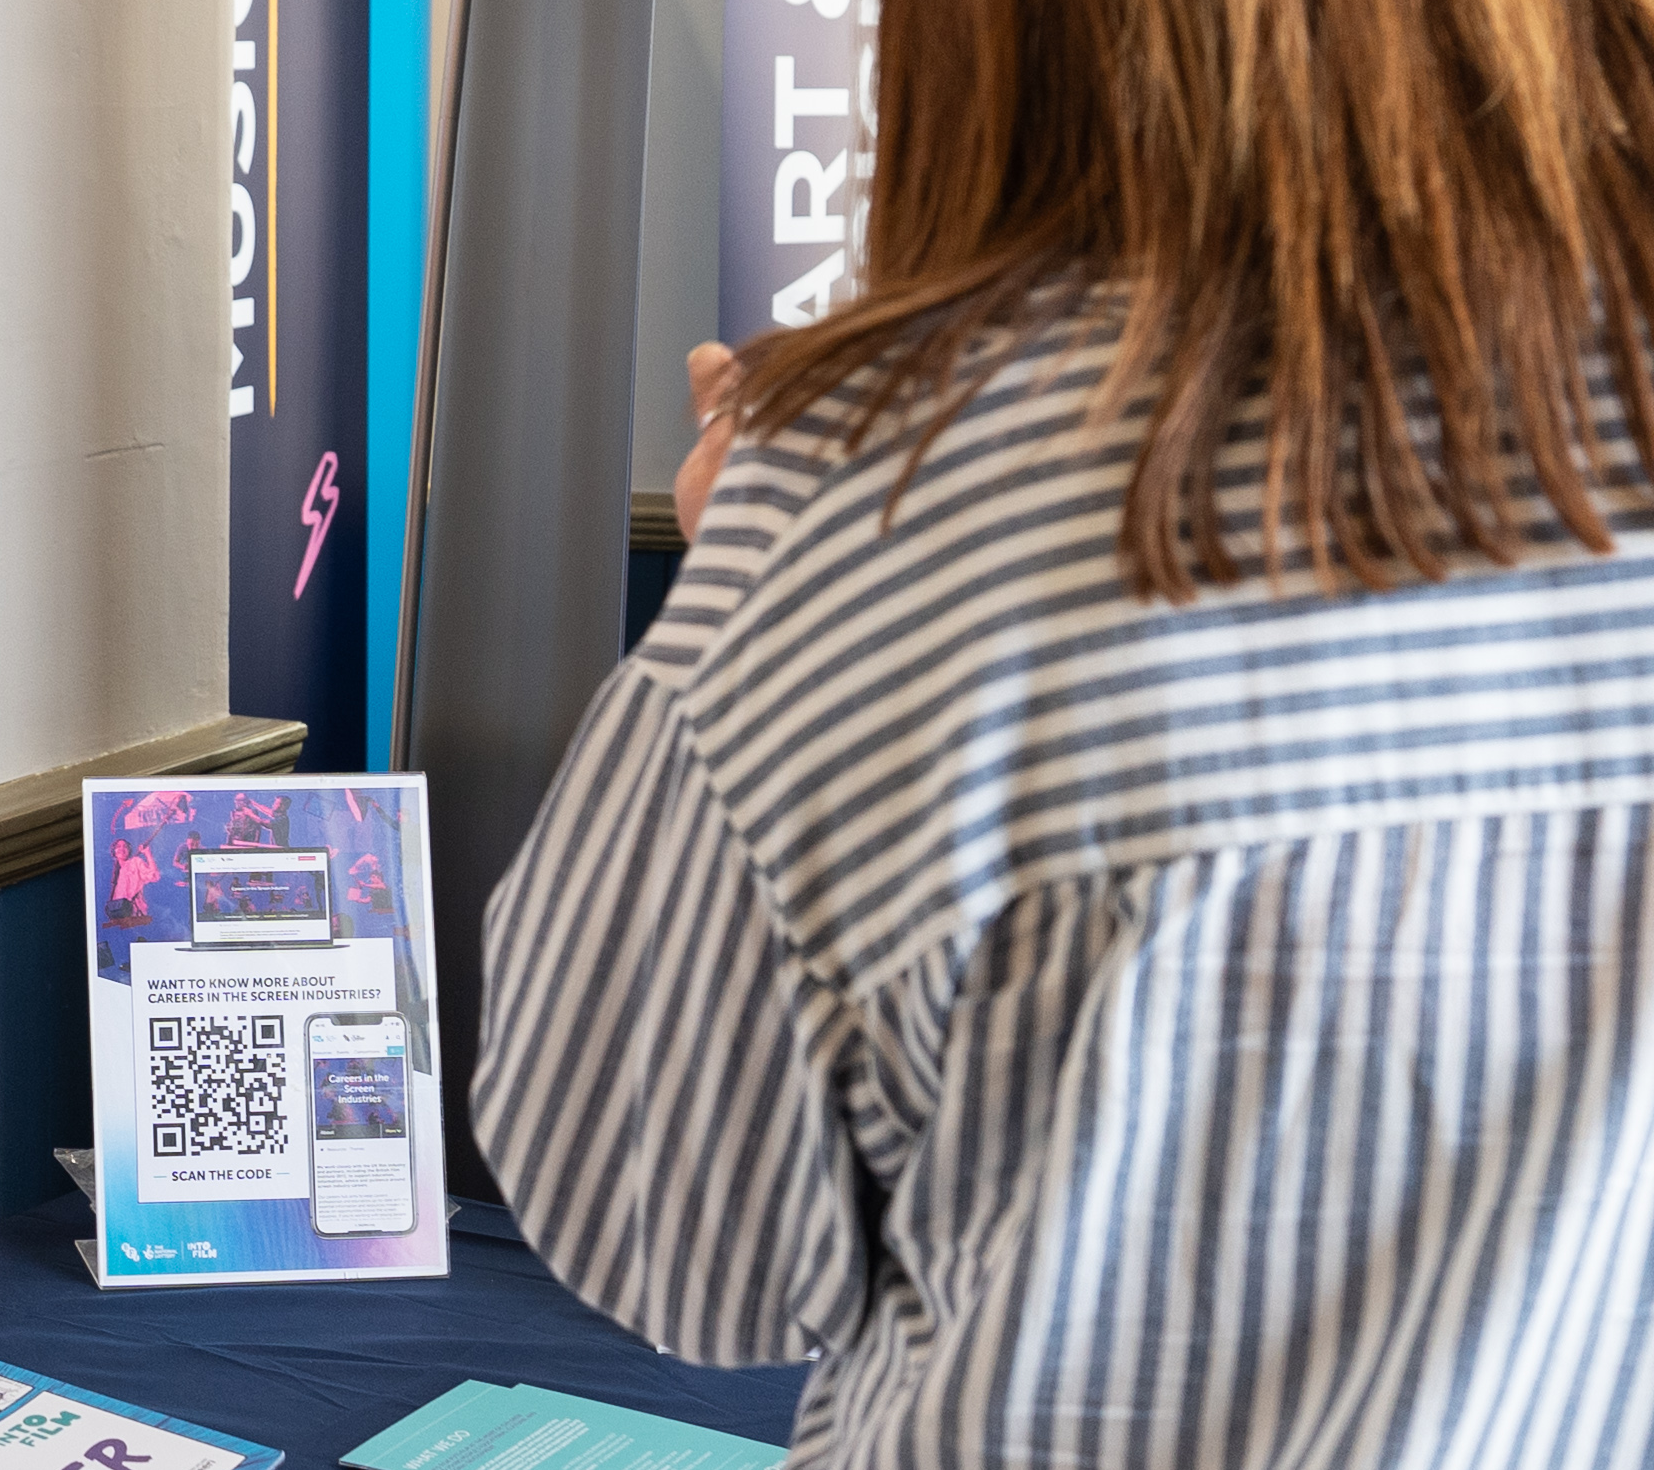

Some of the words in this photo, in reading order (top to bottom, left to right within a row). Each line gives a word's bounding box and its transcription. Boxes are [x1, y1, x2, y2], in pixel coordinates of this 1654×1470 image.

[772, 55, 850, 329] ART
[148, 979, 185, 990] WANT
[187, 979, 206, 989] TO
[209, 978, 249, 989] KNOW
[252, 977, 289, 988] MORE
[292, 976, 335, 987] ABOUT
[148, 992, 204, 1003] CAREERS
[207, 992, 220, 1003] IN
[223, 991, 248, 1002] THE
[251, 990, 299, 1002] SCREEN
[301, 989, 381, 1001] INDUSTRIES?
[328, 1074, 362, 1083] Careers
[364, 1074, 373, 1082] in
[374, 1073, 390, 1082] the
[344, 1084, 375, 1093] Screen
[338, 1094, 382, 1104] Industries
[171, 1170, 205, 1182] SCAN
[208, 1169, 234, 1181] THE
[236, 1168, 272, 1181] CODE
[187, 1241, 211, 1251] INTO
[192, 1249, 217, 1258] FILM
[19, 1410, 81, 1447] FILM
[403, 1449, 438, 1470] WHAT
[432, 1438, 455, 1452] WE
[447, 1430, 471, 1443] DO
